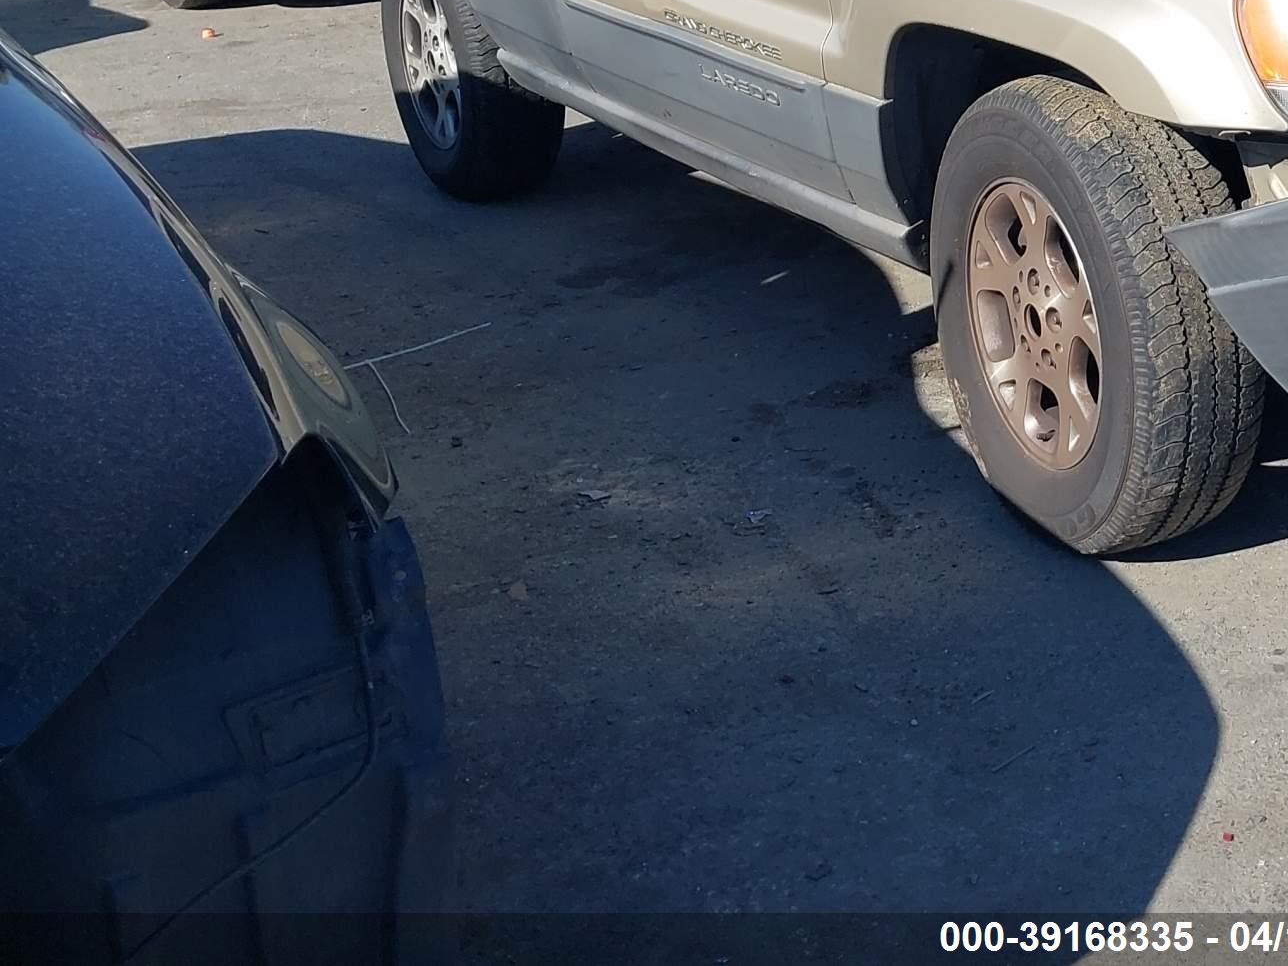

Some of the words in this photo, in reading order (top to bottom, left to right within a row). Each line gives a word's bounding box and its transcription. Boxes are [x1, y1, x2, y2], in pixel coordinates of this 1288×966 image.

[664, 8, 708, 35] GRAND
[709, 26, 783, 61] CHEROKEE
[698, 62, 781, 107] LAREDO
